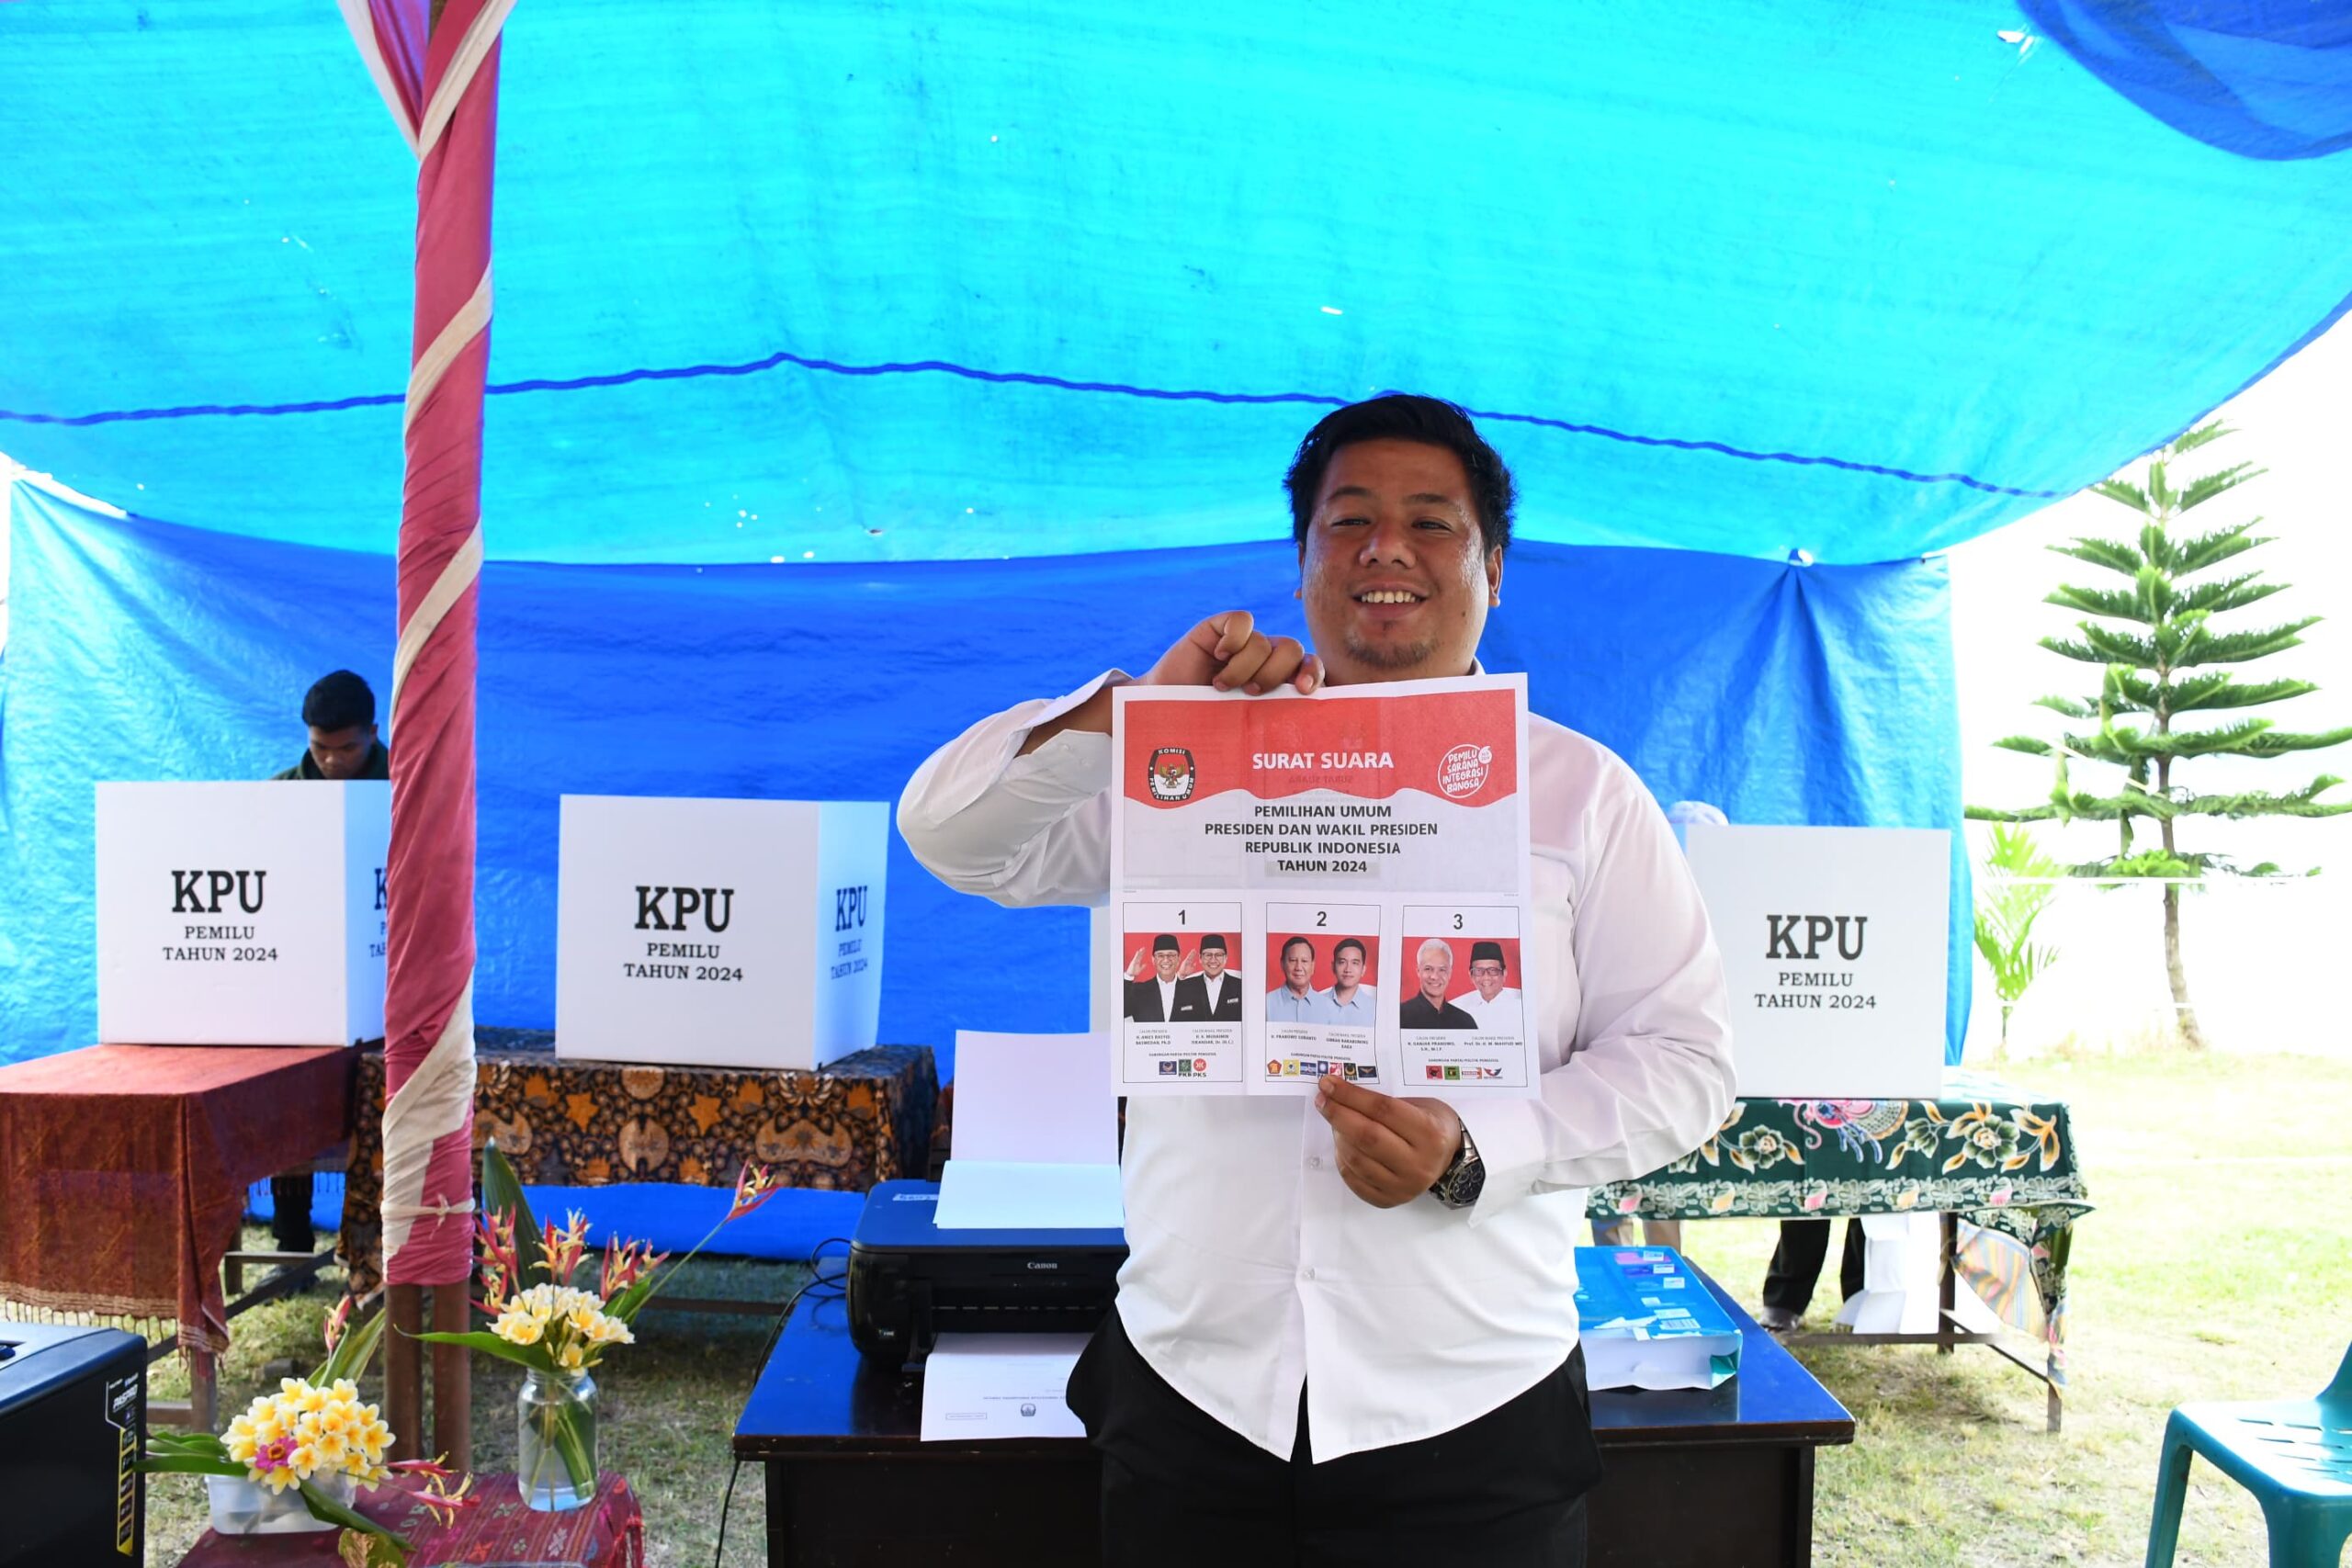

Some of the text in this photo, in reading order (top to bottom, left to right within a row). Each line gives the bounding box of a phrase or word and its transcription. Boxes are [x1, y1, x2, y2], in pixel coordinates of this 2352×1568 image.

[1252, 752, 1394, 770] SURAT SUARA
[1448, 750, 1477, 763] PEMILU
[1447, 759, 1478, 773] SARANA
[1442, 766, 1483, 784] INTEGRASI
[1447, 778, 1479, 793] BANGSA
[1254, 806, 1391, 818] PEMILIHAN UMUM
[1204, 823, 1438, 836] PRESIDEN DAN WAKIL PRESIDEN
[1245, 841, 1401, 854] REPUBLIK INDONESIA
[1277, 860, 1367, 873] TAHUN 2024
[171, 870, 266, 914] KPU
[635, 886, 734, 932] KPU
[835, 886, 867, 931] KPU
[1178, 909, 1186, 925] 1
[1317, 911, 1327, 927] 2
[1453, 914, 1464, 930] 3
[185, 926, 255, 940] PEMILU
[1766, 914, 1868, 961] KPU
[163, 947, 278, 961] TAHUN 2024
[647, 942, 720, 959] PEMILU
[624, 964, 743, 981] TAHUN 2024
[1778, 972, 1854, 987] PEMILU
[1755, 994, 1877, 1010] TAHUN 2024
